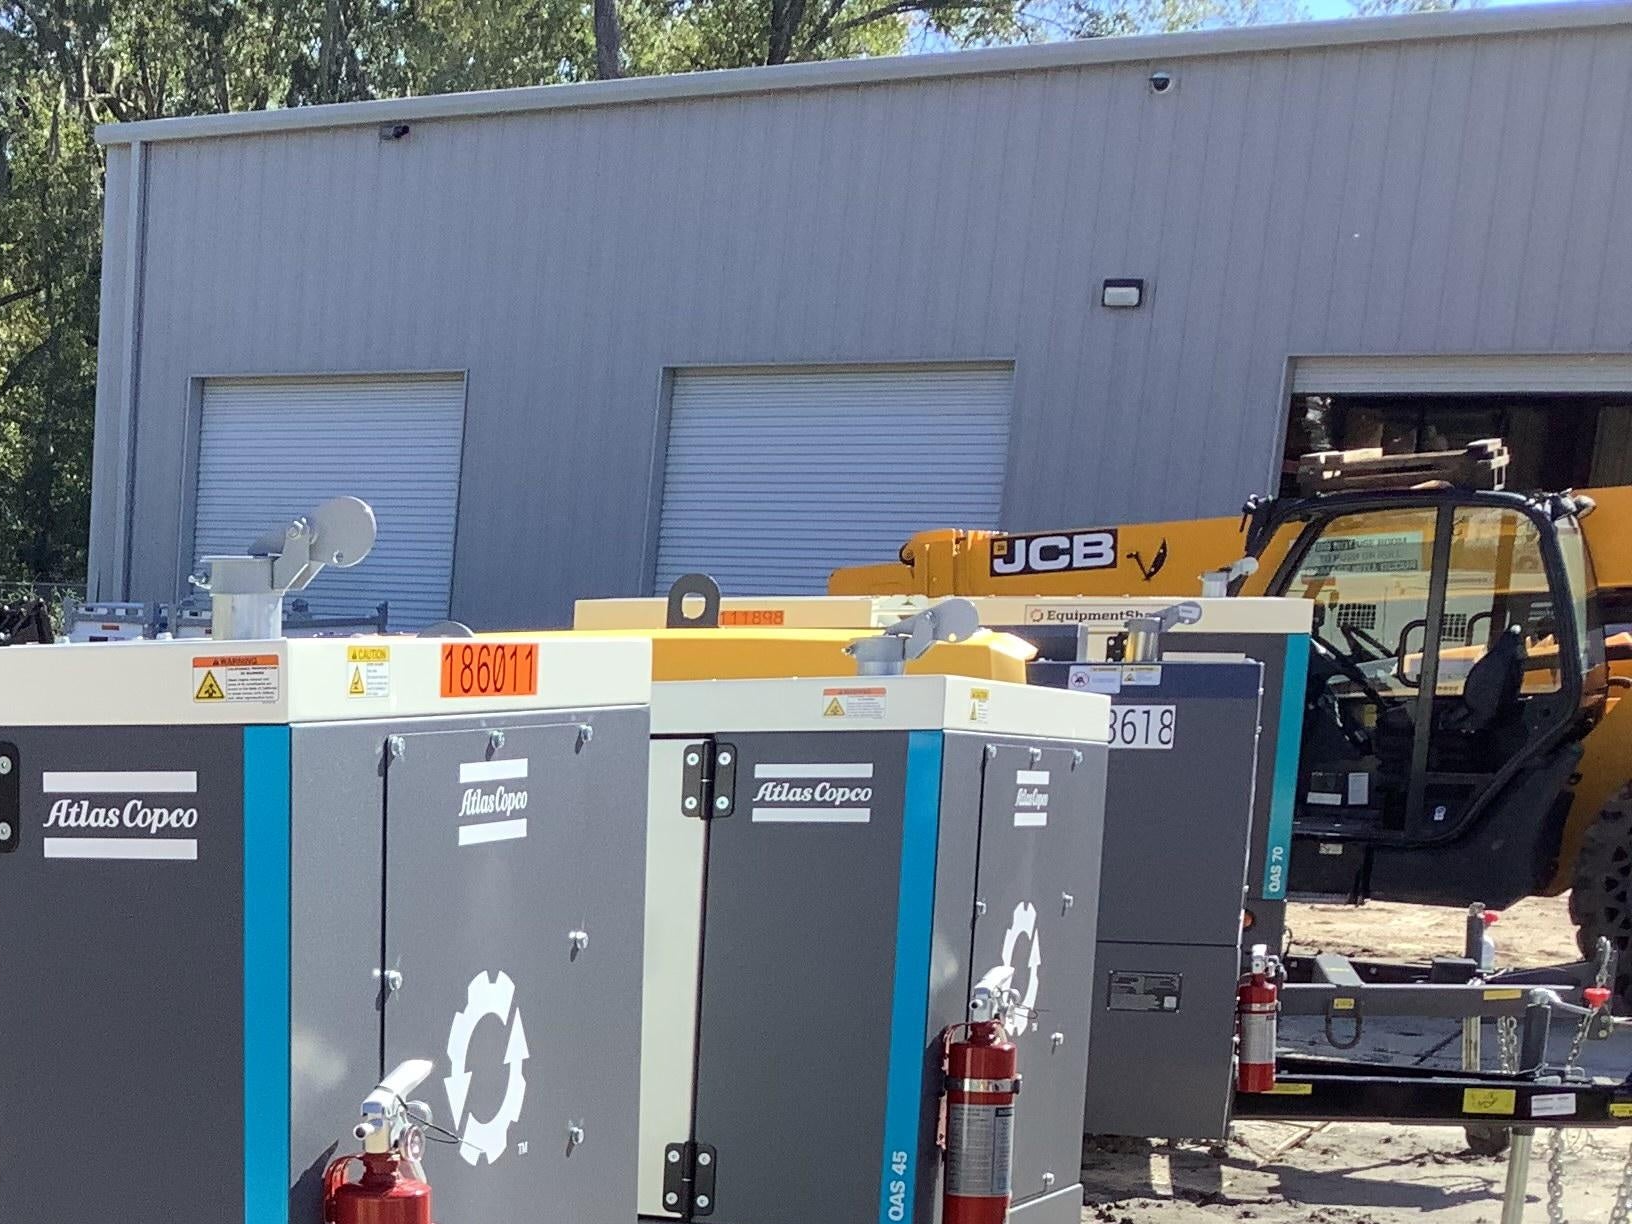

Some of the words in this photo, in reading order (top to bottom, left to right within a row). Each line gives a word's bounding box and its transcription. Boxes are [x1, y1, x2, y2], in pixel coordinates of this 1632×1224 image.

[992, 532, 1115, 574] JCB
[445, 644, 534, 694] 186011
[458, 788, 495, 817] Atlas
[495, 785, 528, 817] Copco
[753, 782, 813, 802] Atlas
[814, 782, 873, 805] Copco
[43, 799, 121, 828] Atlas
[122, 799, 198, 834] Copco
[1272, 846, 1284, 863] 70
[891, 1150, 908, 1176] 45
